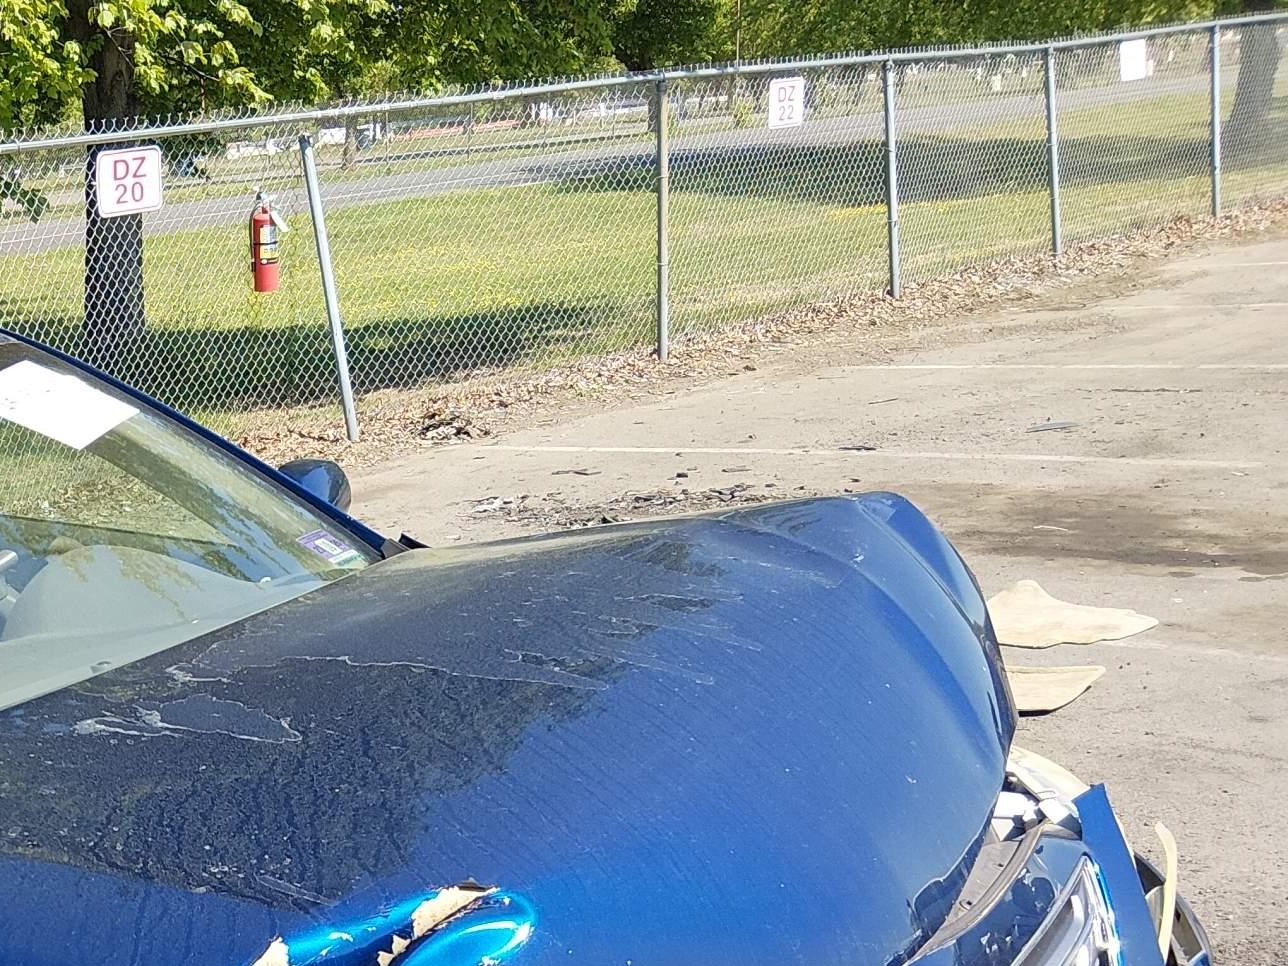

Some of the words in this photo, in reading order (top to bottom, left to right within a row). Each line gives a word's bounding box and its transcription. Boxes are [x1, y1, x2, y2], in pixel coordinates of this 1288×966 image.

[778, 86, 795, 103] DZ
[779, 105, 793, 120] 22
[113, 156, 146, 181] DZ
[115, 182, 143, 204] 20
